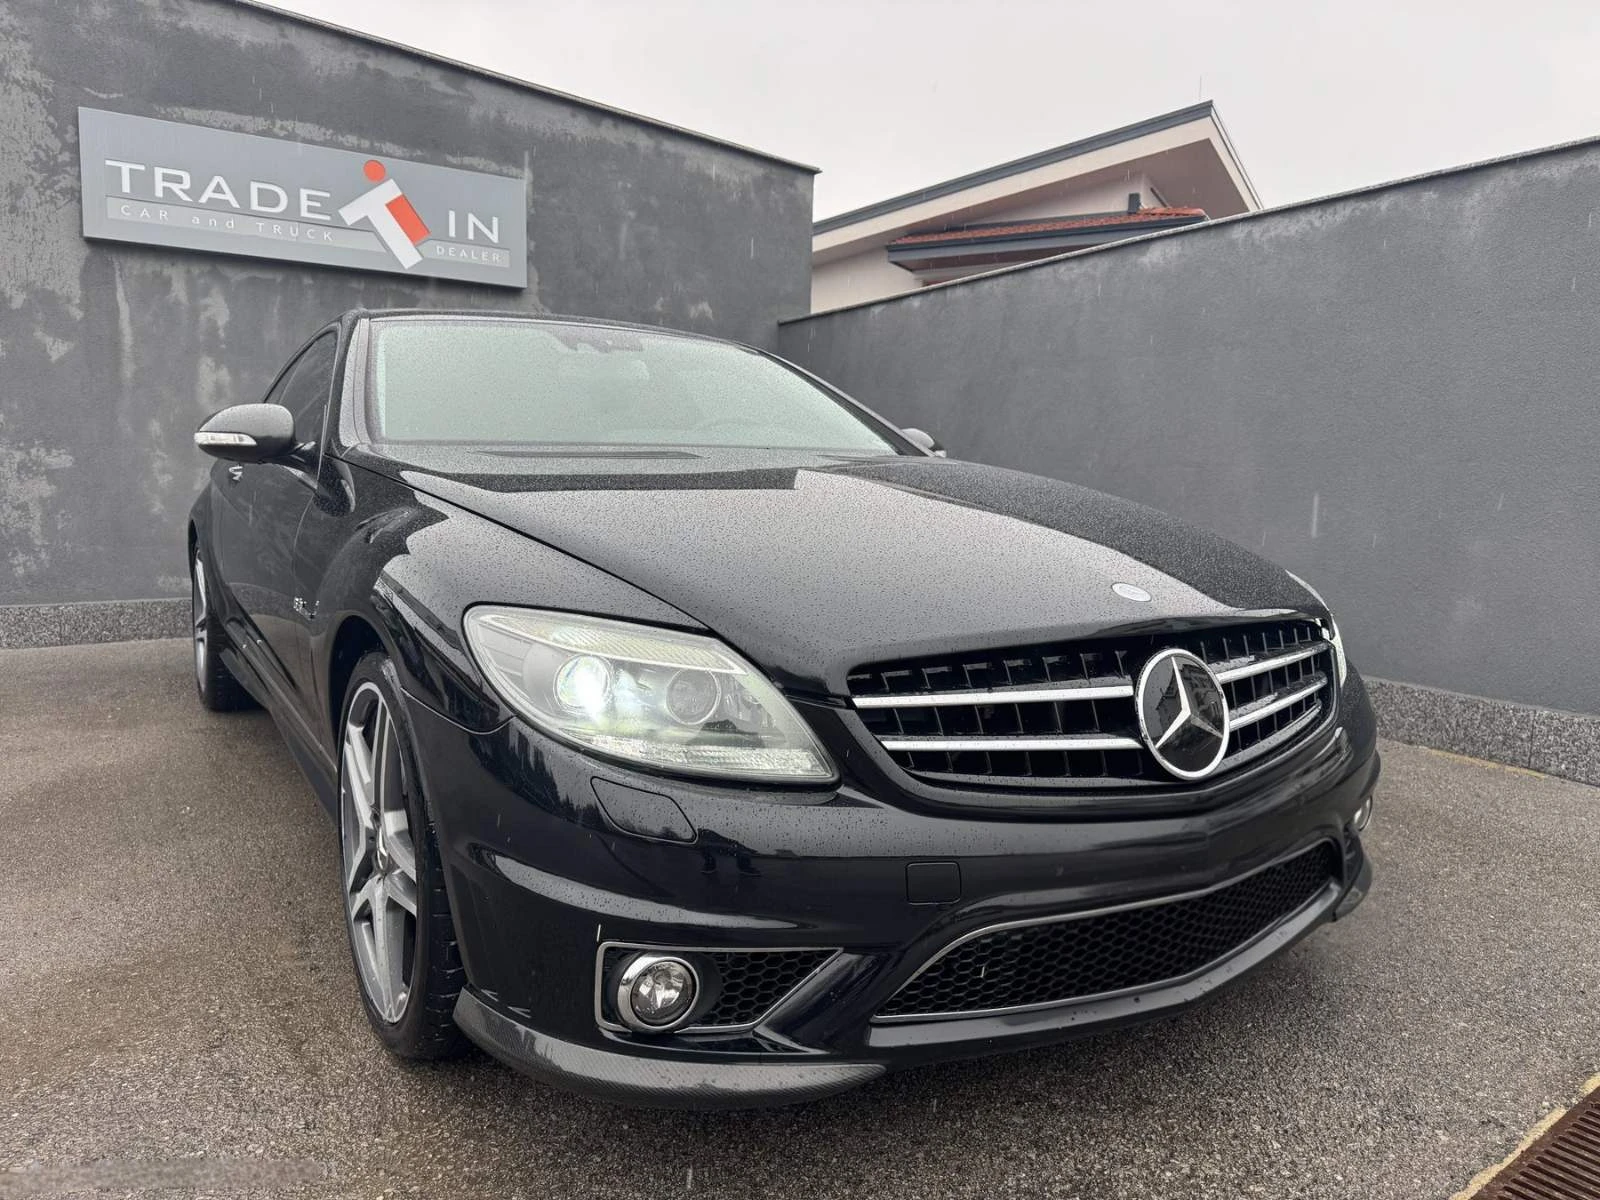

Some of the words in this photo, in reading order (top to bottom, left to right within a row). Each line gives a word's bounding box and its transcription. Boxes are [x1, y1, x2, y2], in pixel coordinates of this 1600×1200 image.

[105, 159, 331, 221] TRADE
[448, 210, 499, 244] IN
[120, 204, 169, 221] CAR
[191, 216, 235, 230] and
[256, 222, 334, 241] TRUCK
[436, 245, 501, 263] DEALER
